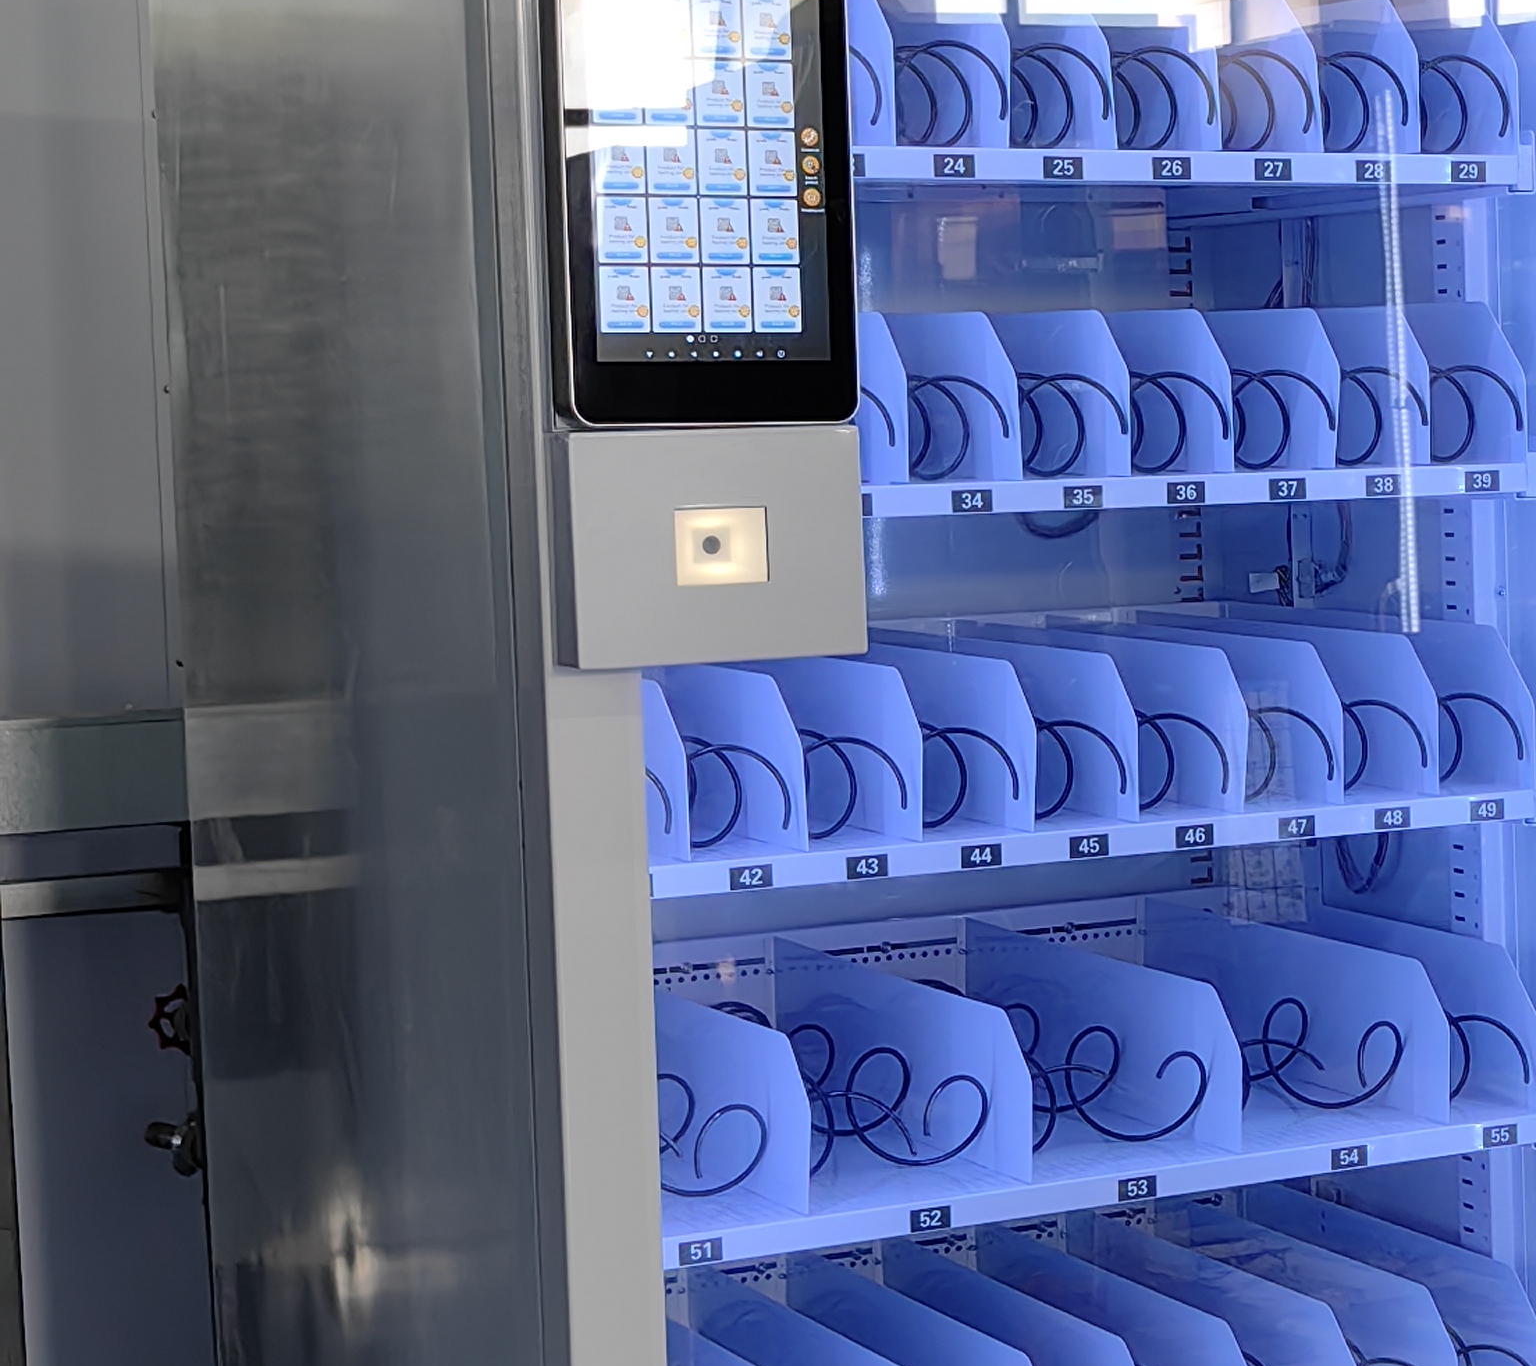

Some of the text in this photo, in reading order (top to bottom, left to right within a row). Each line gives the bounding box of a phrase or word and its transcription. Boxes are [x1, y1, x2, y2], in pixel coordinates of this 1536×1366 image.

[943, 157, 1479, 179] 24 25 26 27 28 29
[961, 473, 1492, 509] 34 35 36 37 38 39
[738, 802, 1497, 885] 42 43 44 45 46 47 48 49
[689, 1127, 1510, 1260] 51 52 53 54 55
